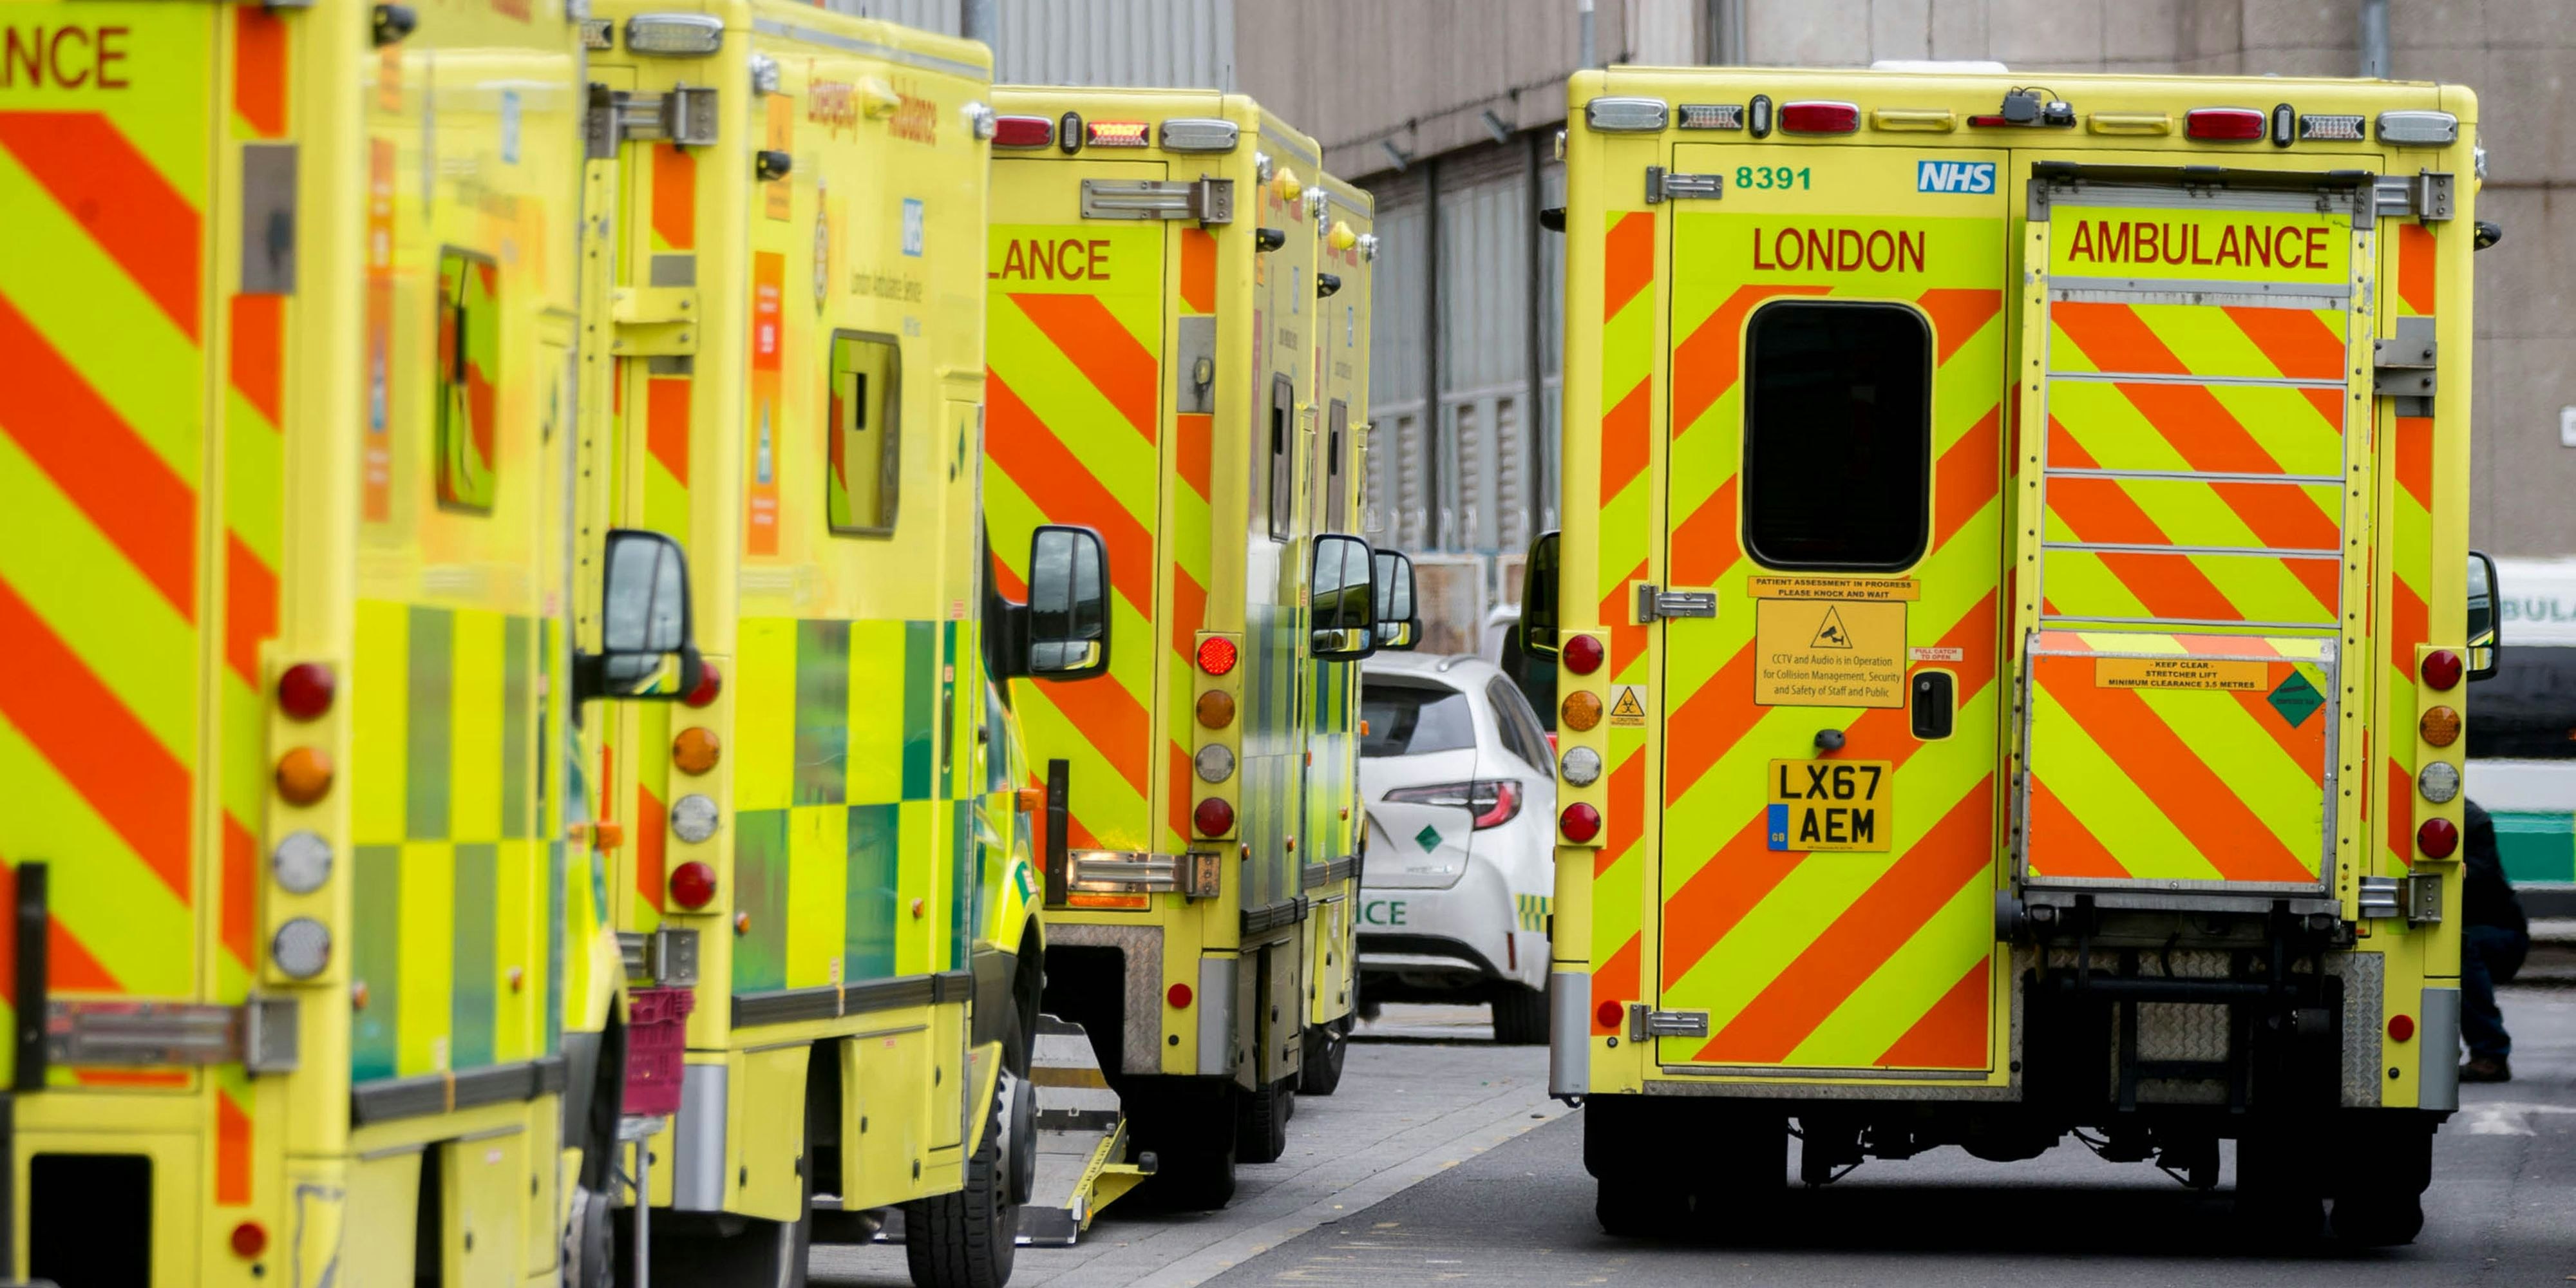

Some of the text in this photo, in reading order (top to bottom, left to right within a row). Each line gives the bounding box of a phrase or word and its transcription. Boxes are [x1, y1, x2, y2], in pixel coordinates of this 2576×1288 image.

[0, 25, 131, 89] NCE
[1736, 166, 1811, 190] 8391
[1919, 163, 1993, 193] NHS
[1754, 227, 1925, 272] LONDON
[2068, 220, 2329, 269] AMBULANCE
[987, 239, 1111, 281] ANCE
[1772, 654, 1892, 667] CCTV and Audio is in Operation
[1763, 670, 1901, 683] for Collision Management, Security
[1774, 685, 1889, 697] and Safety of Staff and Public
[1781, 764, 1882, 800] LX67
[1772, 832, 1785, 842] GB
[1799, 808, 1874, 843] AEM
[1356, 900, 1407, 925] CE
